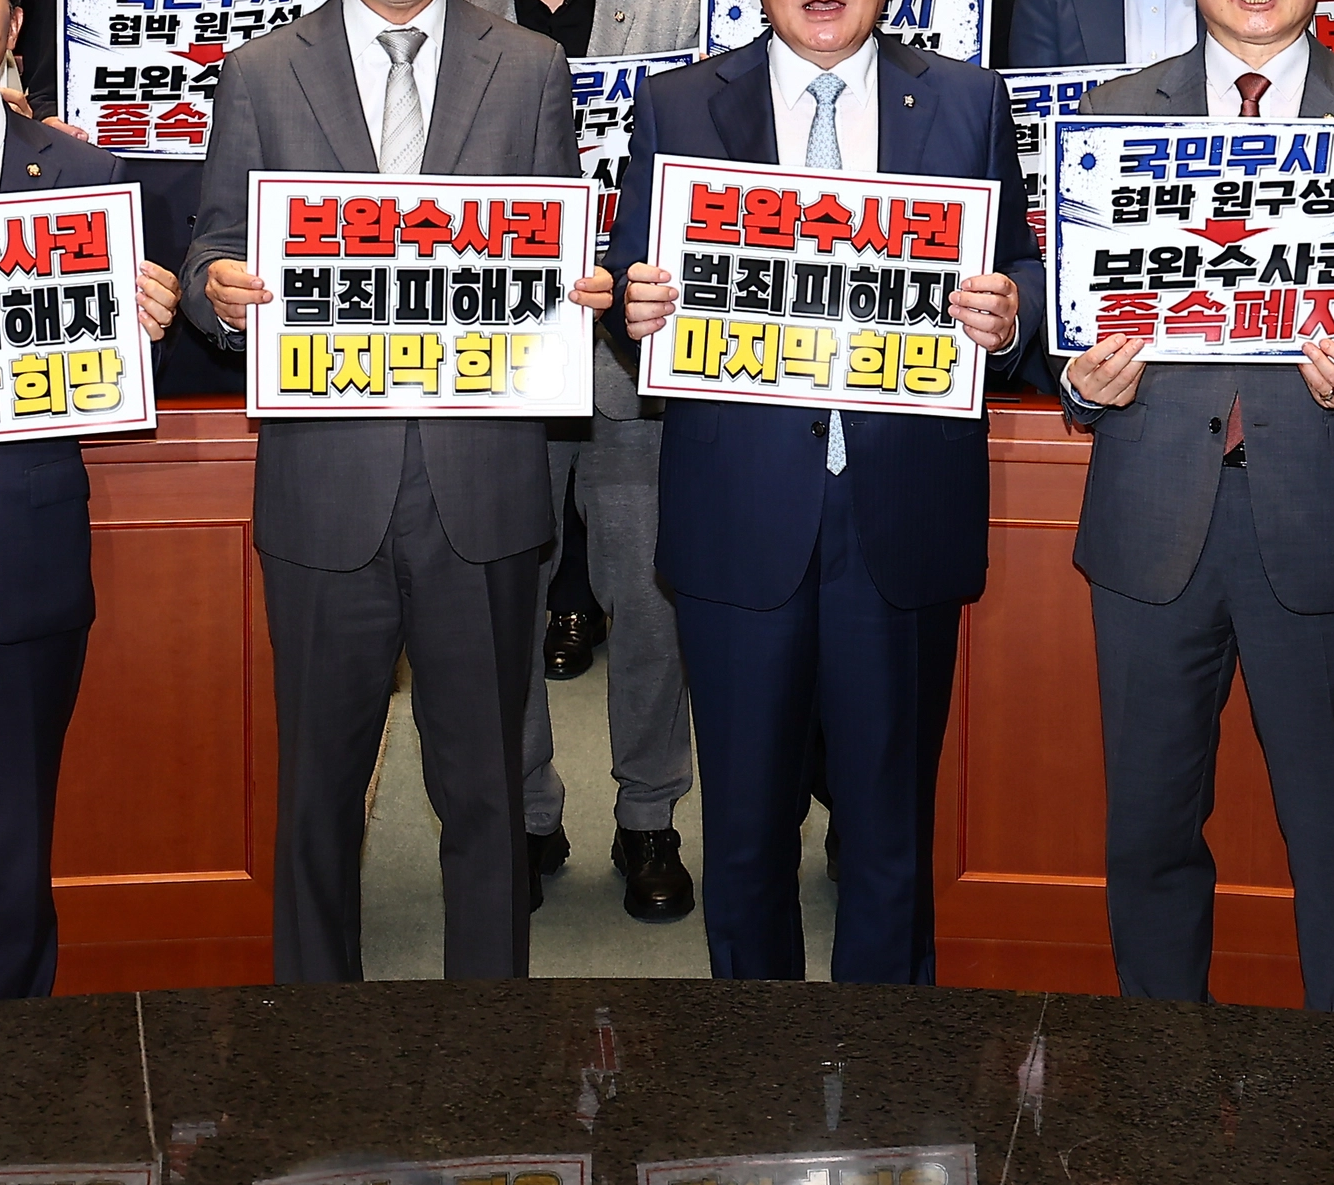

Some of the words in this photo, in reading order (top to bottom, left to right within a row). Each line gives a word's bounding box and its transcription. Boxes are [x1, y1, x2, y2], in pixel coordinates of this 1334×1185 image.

[108, 12, 180, 46] 협박
[96, 102, 207, 146] 졸속
[1120, 132, 1331, 179] 국민무시
[282, 196, 564, 260] 보완수사권
[684, 181, 964, 264] 보완수사권
[1111, 184, 1196, 224] 협박
[10, 347, 125, 418] 희망
[278, 332, 446, 397] 마지막
[670, 316, 839, 389] 마지막
[844, 328, 959, 397] 희망
